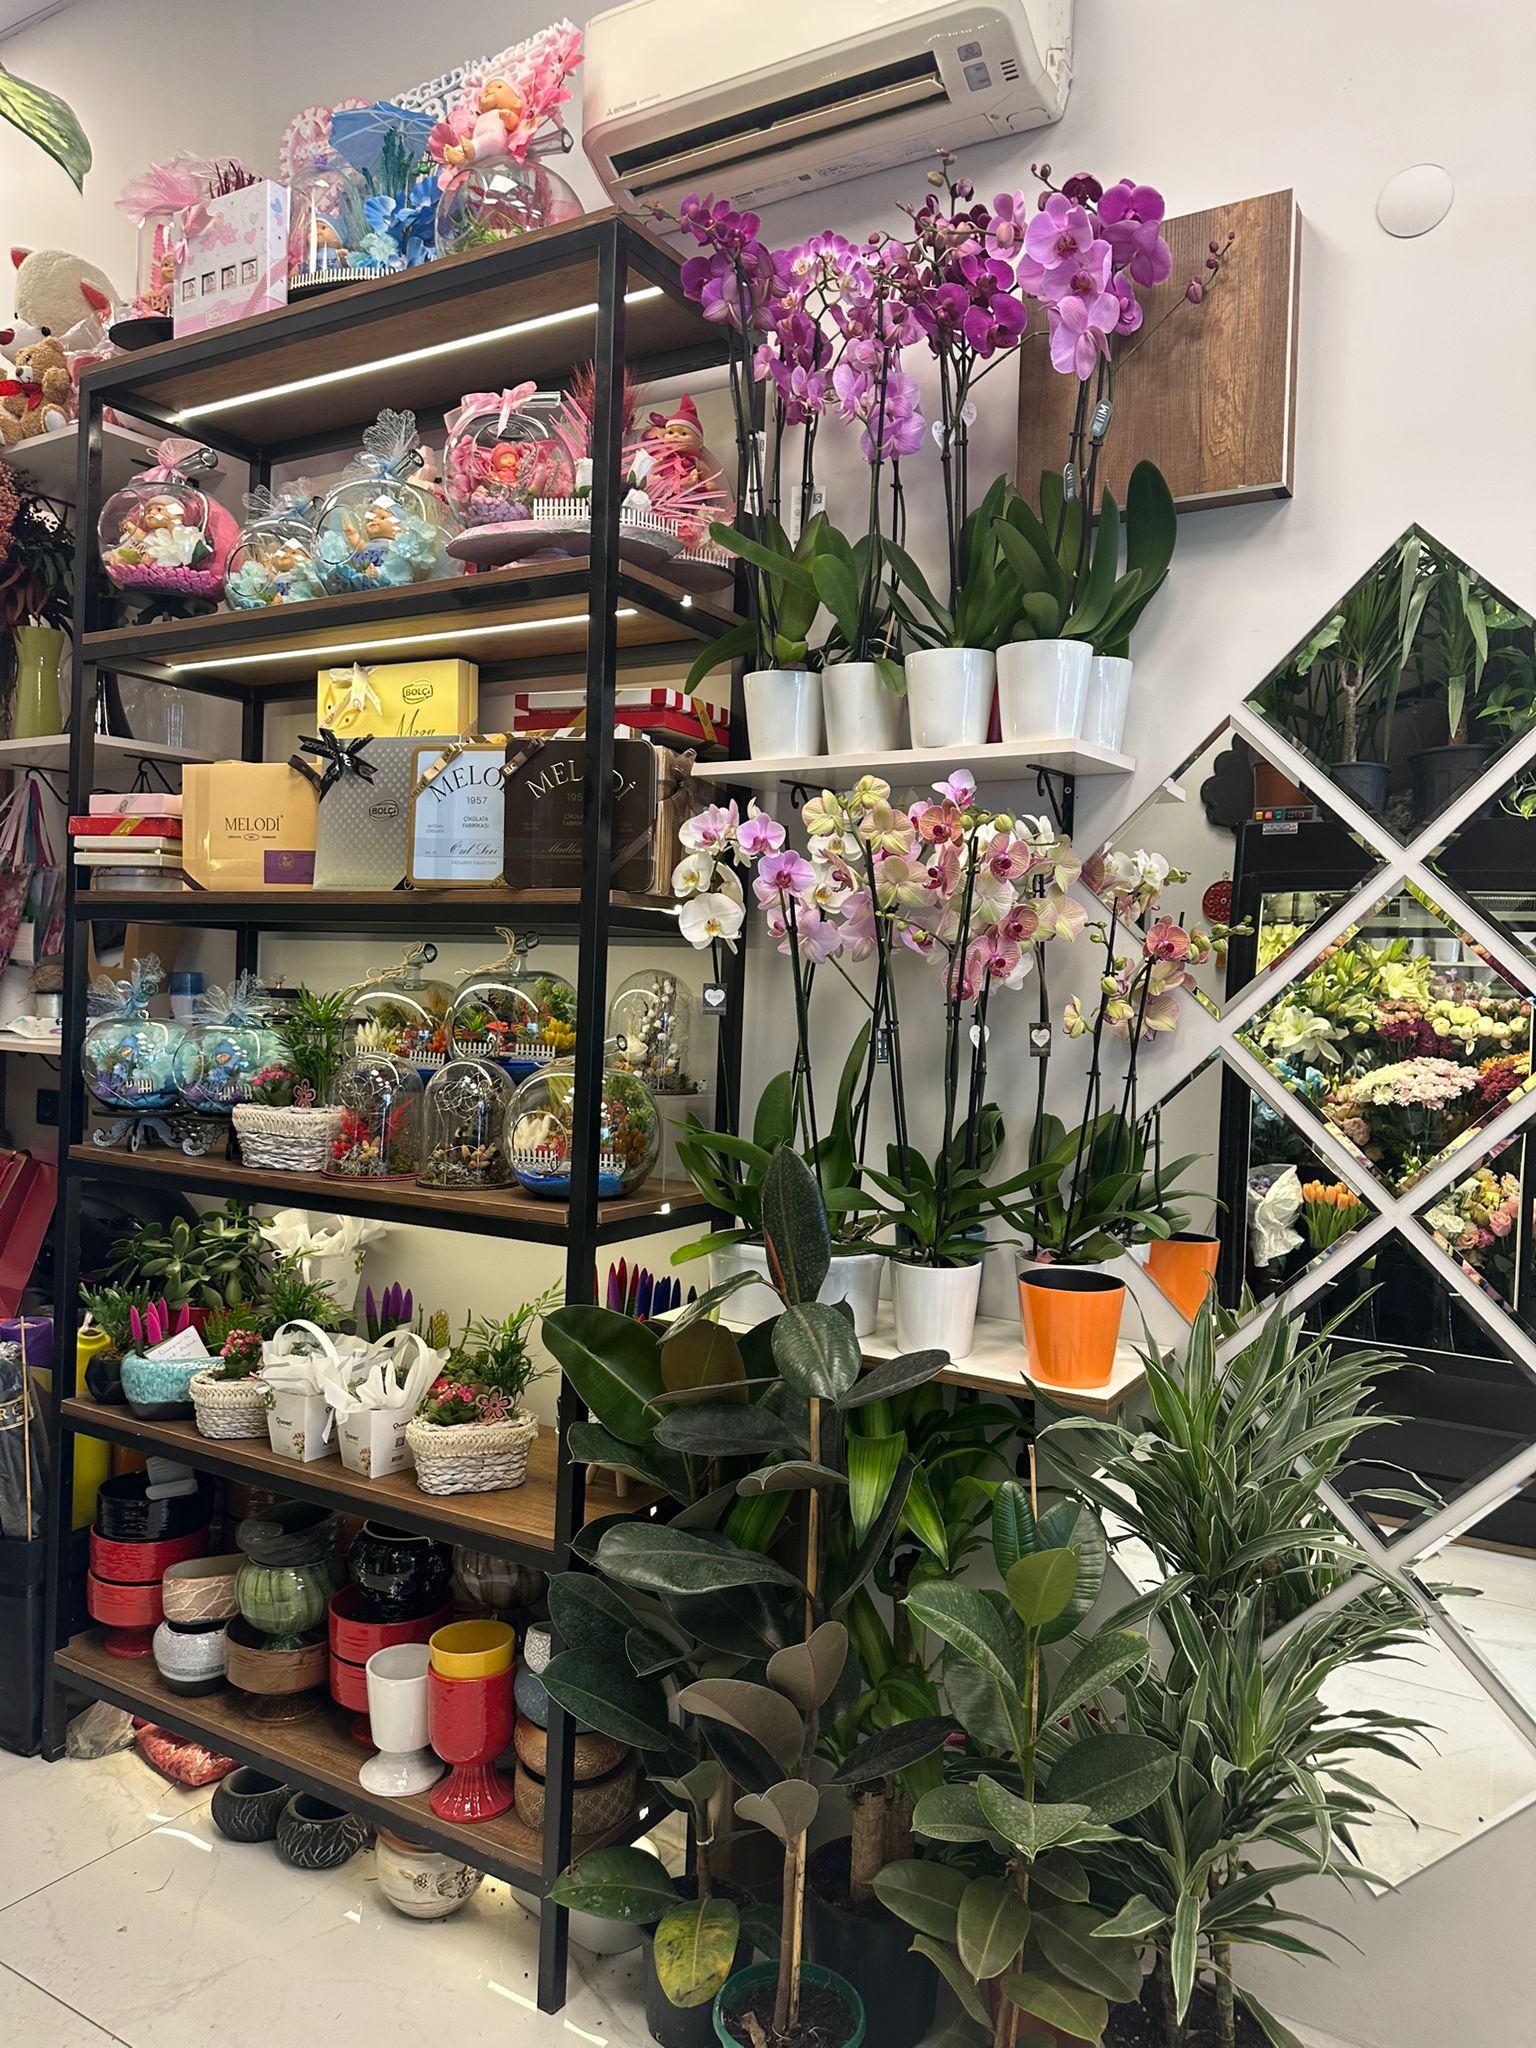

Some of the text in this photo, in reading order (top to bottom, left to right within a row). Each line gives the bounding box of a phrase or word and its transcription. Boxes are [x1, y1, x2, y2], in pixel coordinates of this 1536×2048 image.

[396, 708, 436, 736] Moon
[429, 765, 505, 803] MELO
[466, 796, 488, 805] 1957
[567, 793, 584, 802] 195
[225, 815, 280, 831] MELODİ
